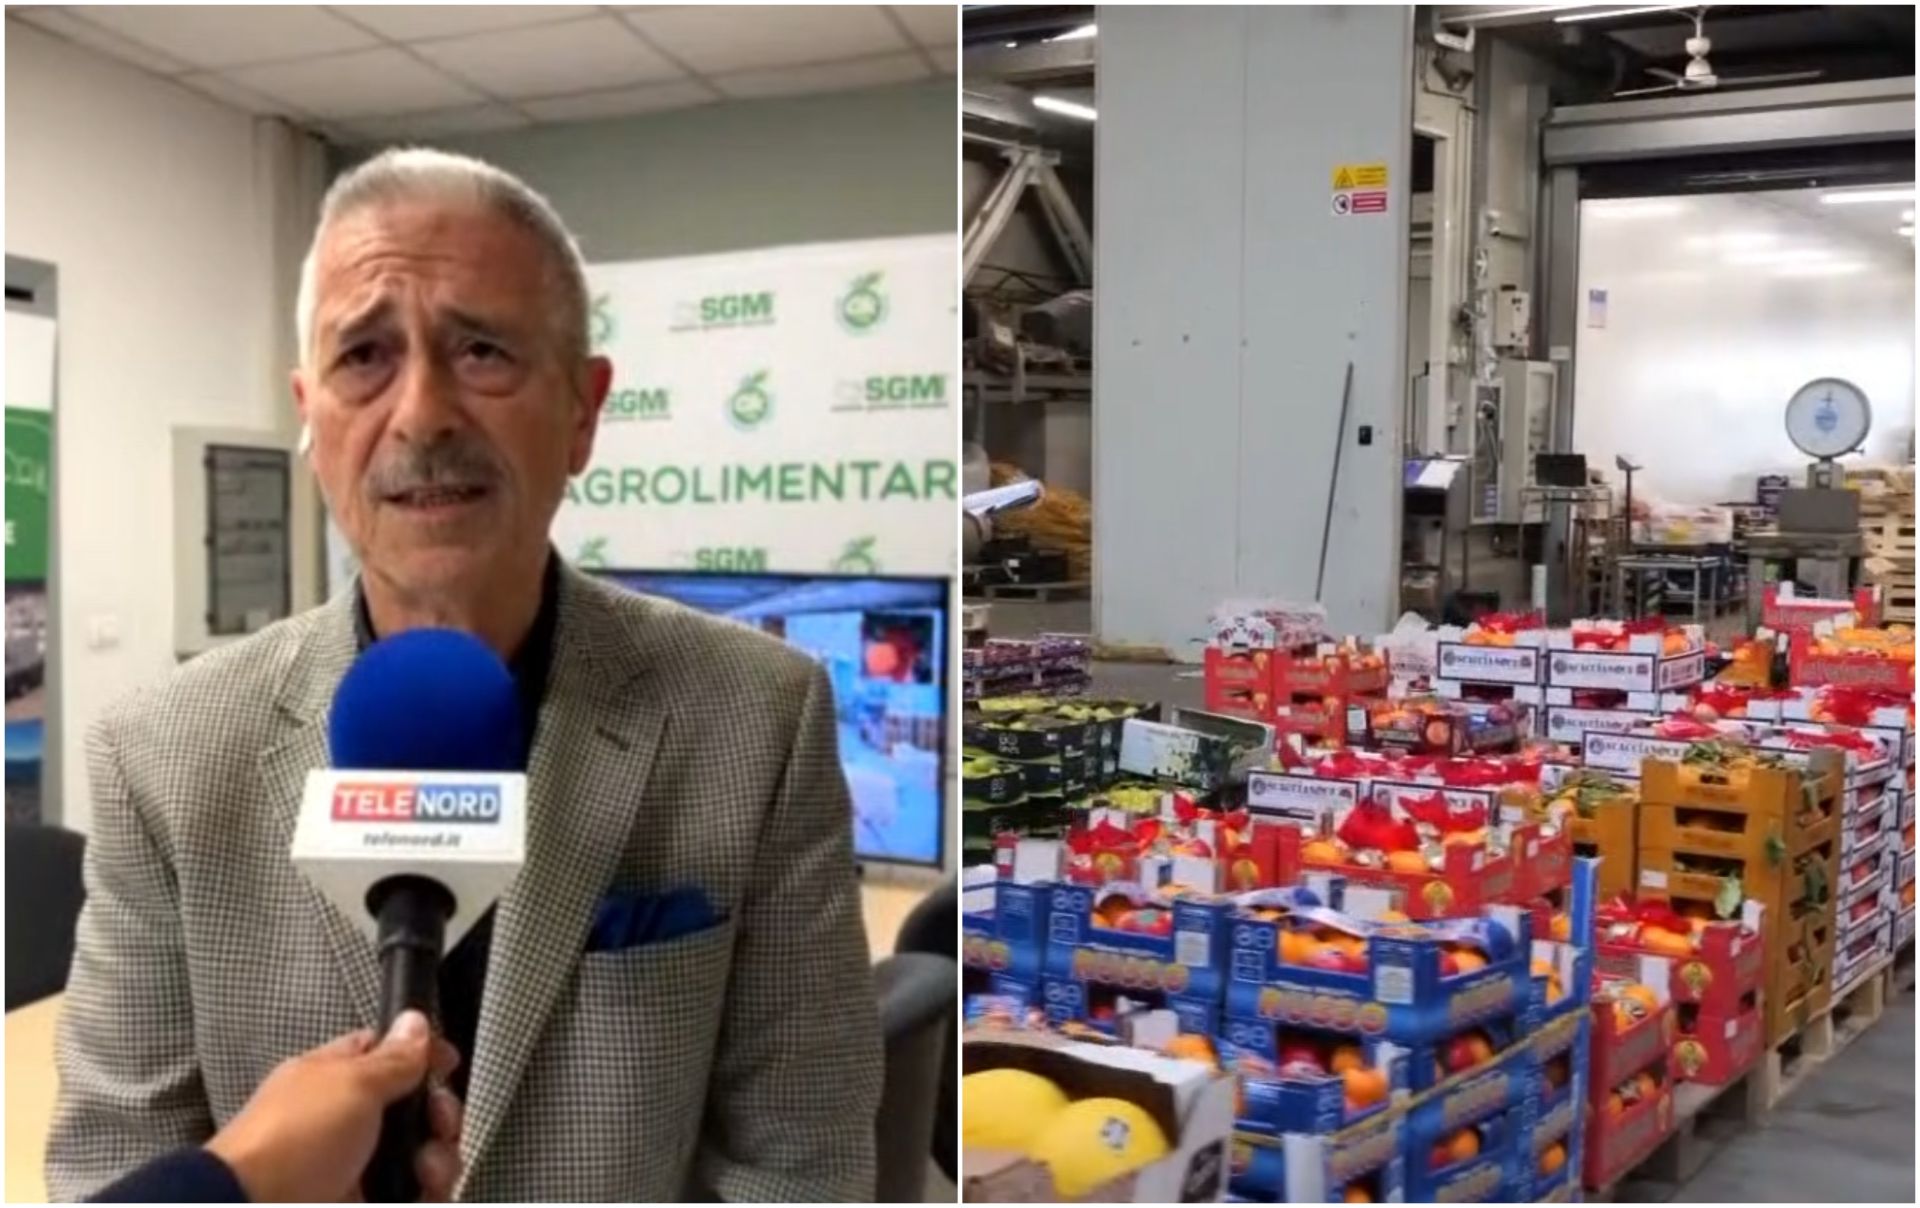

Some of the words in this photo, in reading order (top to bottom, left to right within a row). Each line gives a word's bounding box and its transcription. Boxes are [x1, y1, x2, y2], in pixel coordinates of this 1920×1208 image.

[700, 293, 774, 322] SGM
[866, 375, 945, 401] SGM
[696, 547, 767, 570] SGM
[335, 789, 498, 818] TELENORD
